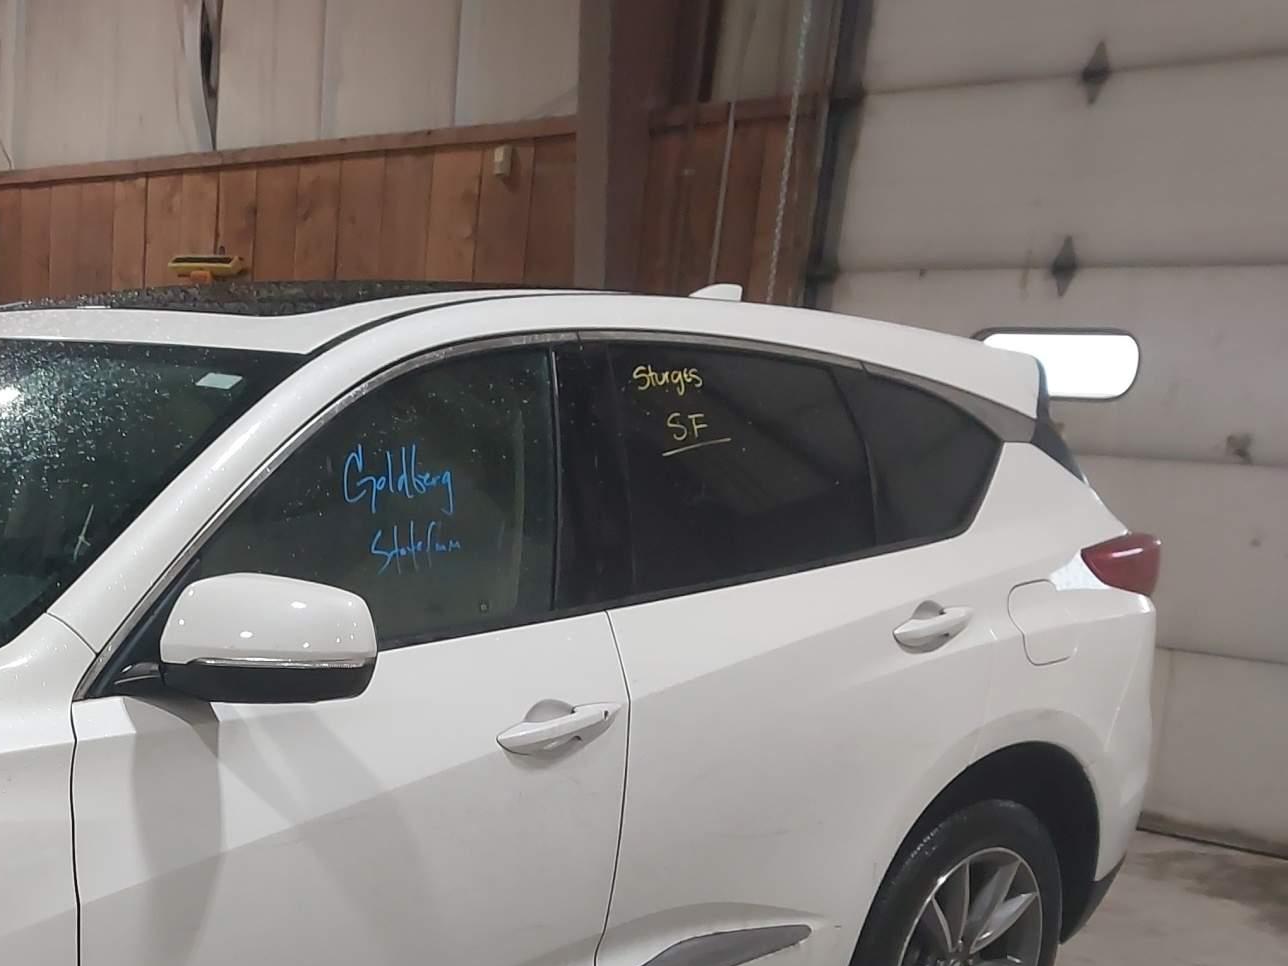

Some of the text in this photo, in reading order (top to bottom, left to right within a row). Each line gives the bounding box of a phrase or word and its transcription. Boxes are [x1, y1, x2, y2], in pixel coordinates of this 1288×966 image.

[632, 364, 703, 396] Sturges
[666, 412, 708, 441] SF
[343, 443, 454, 516] Goldberg
